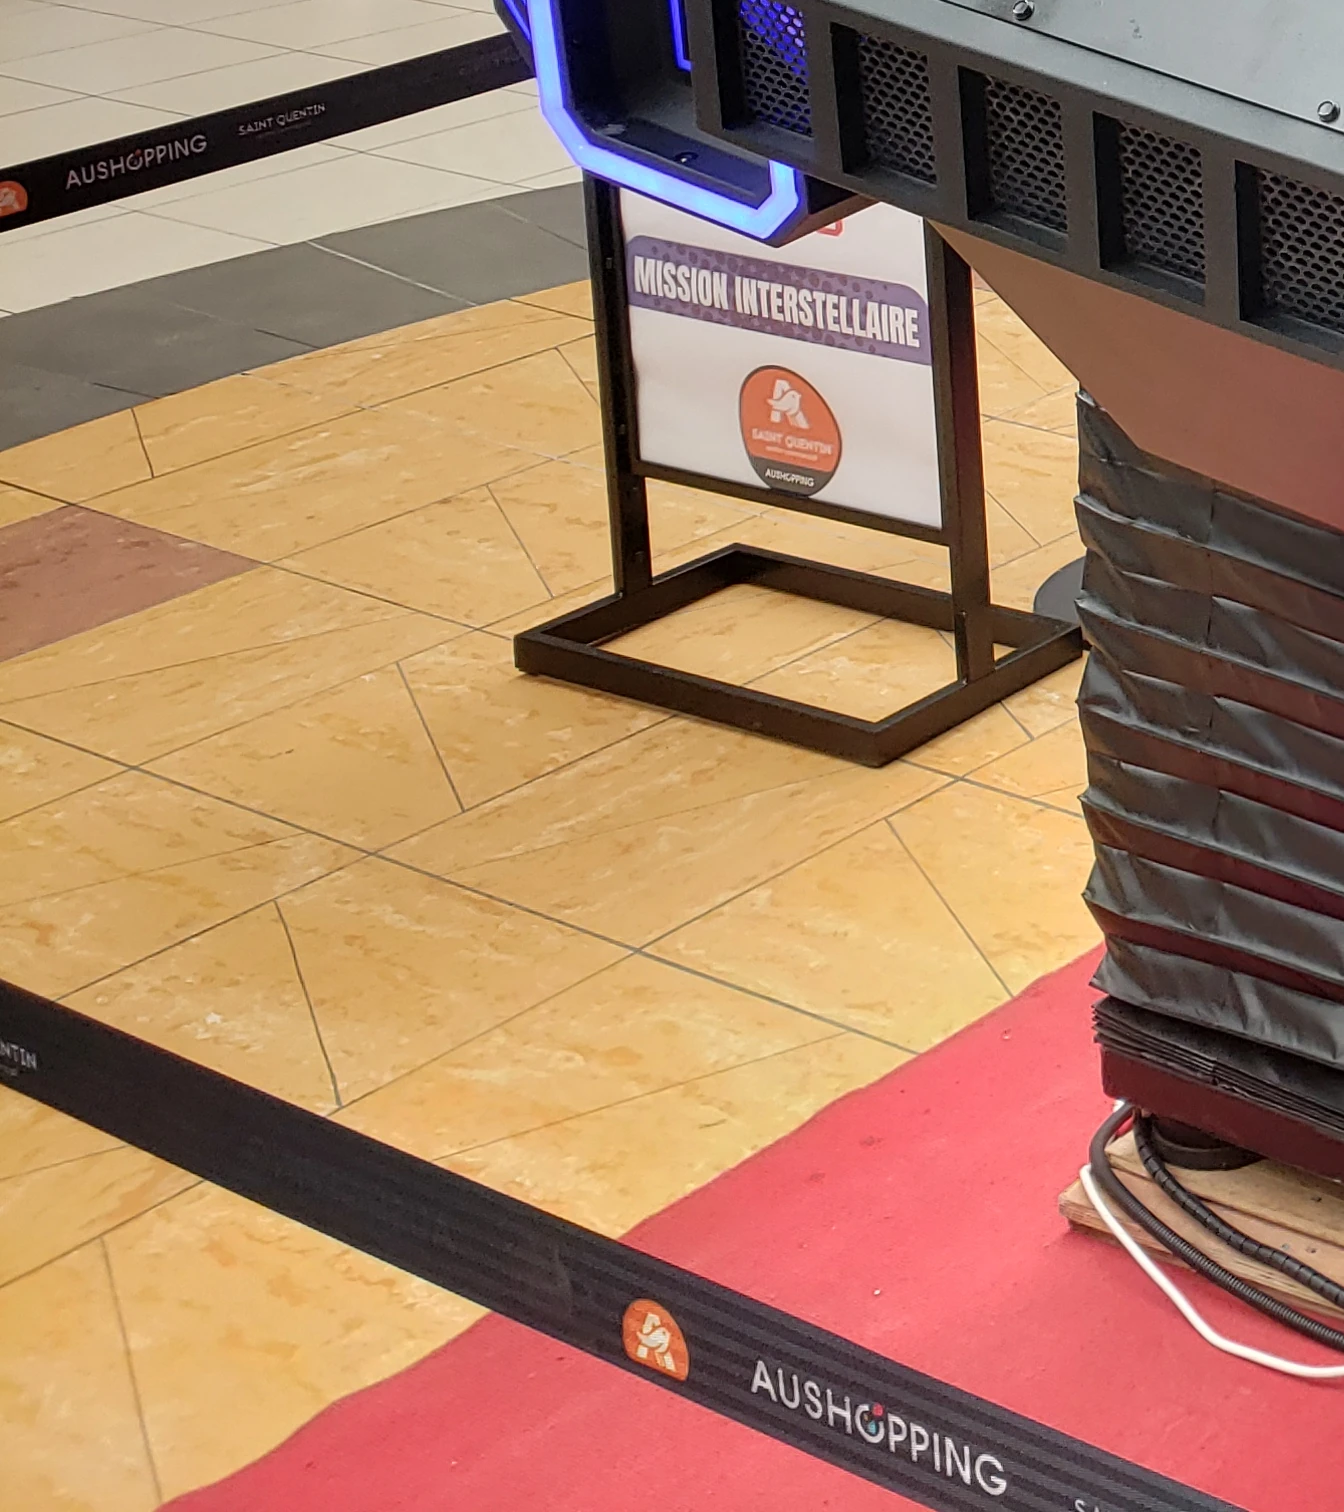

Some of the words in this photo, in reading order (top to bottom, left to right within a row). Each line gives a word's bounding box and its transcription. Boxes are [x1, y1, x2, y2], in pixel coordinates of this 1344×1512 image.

[238, 117, 274, 136] SAINT
[276, 102, 326, 126] QUENTIN
[66, 134, 208, 190] AUSHOPPING
[632, 255, 729, 312] MISSION
[734, 276, 921, 349] INTERSTELLAIRE
[750, 1358, 1008, 1496] AUSHOPPING
